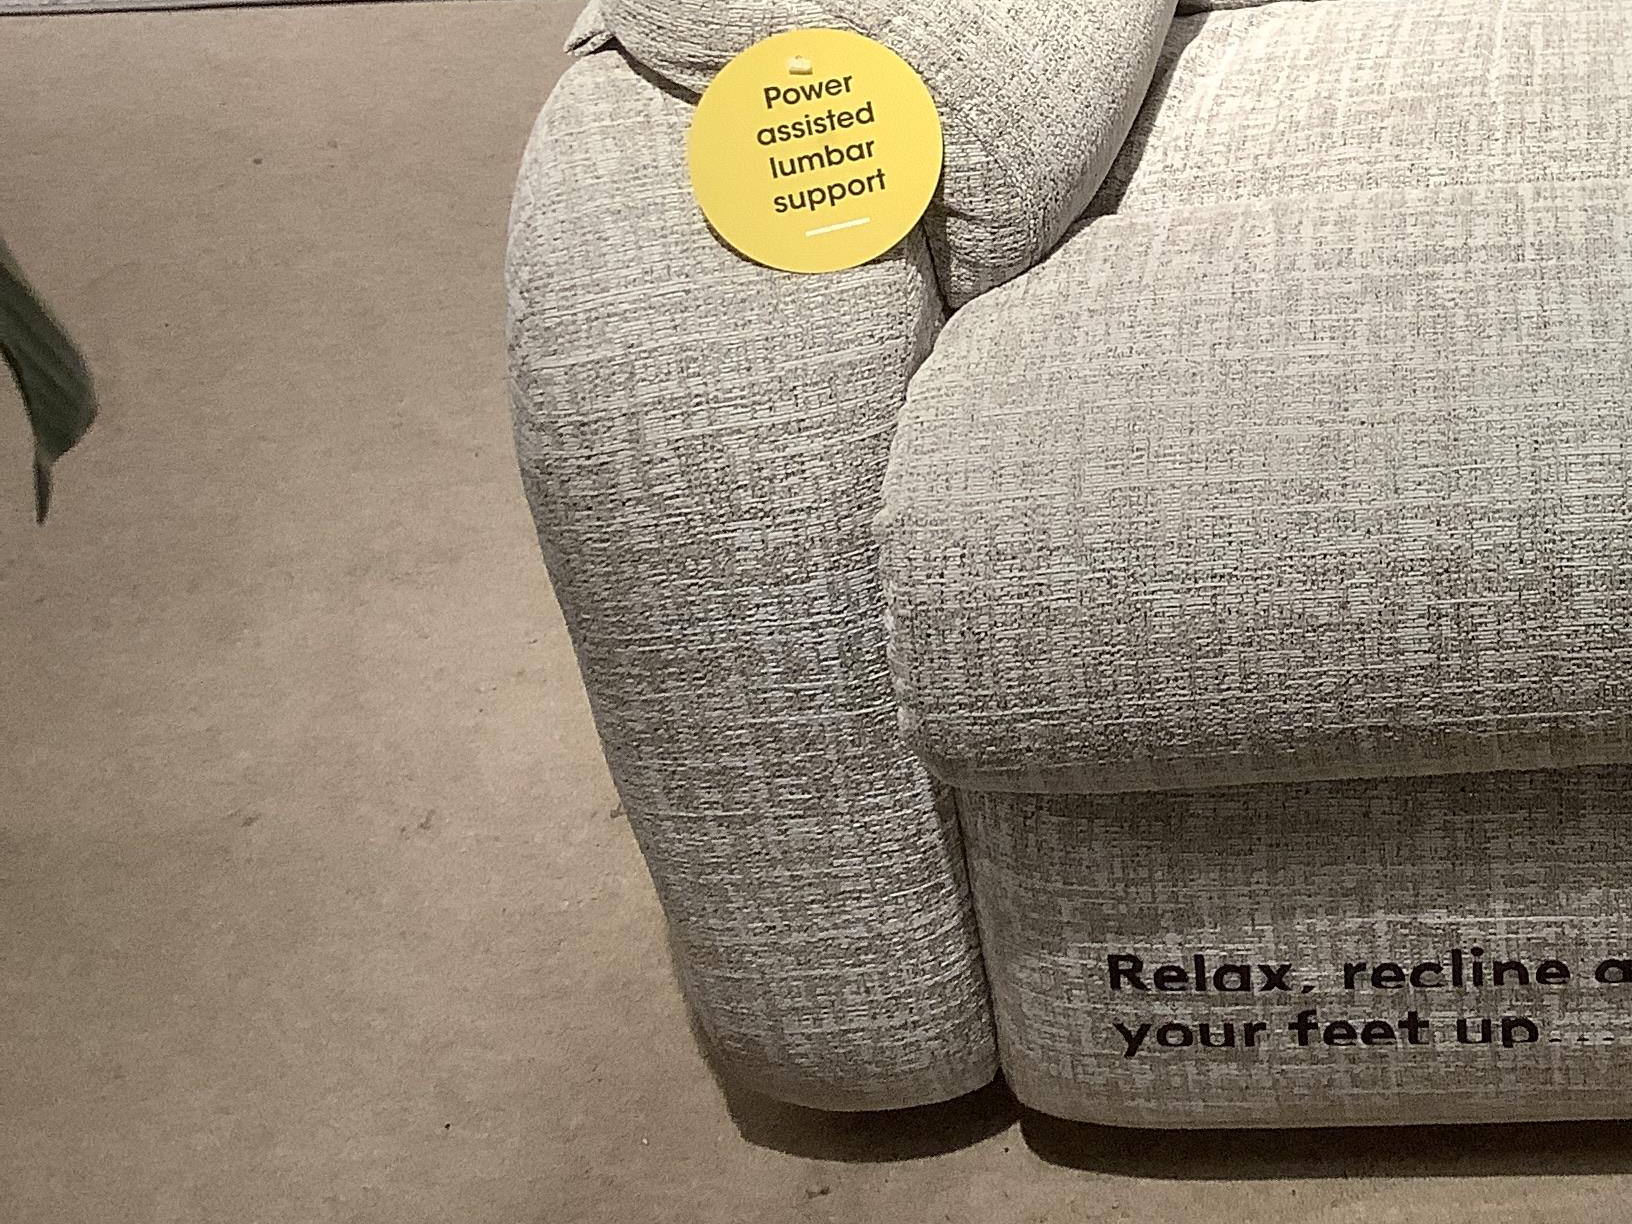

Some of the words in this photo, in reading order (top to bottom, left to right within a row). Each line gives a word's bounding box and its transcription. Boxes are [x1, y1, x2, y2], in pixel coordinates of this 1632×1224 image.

[763, 75, 853, 109] Power
[756, 101, 876, 146] assisted
[769, 140, 876, 179] lumbar
[773, 168, 886, 213] support
[1107, 953, 1316, 994] Relax,
[1342, 946, 1572, 990] recline
[1112, 1021, 1268, 1058] your
[1287, 1009, 1430, 1048] feet
